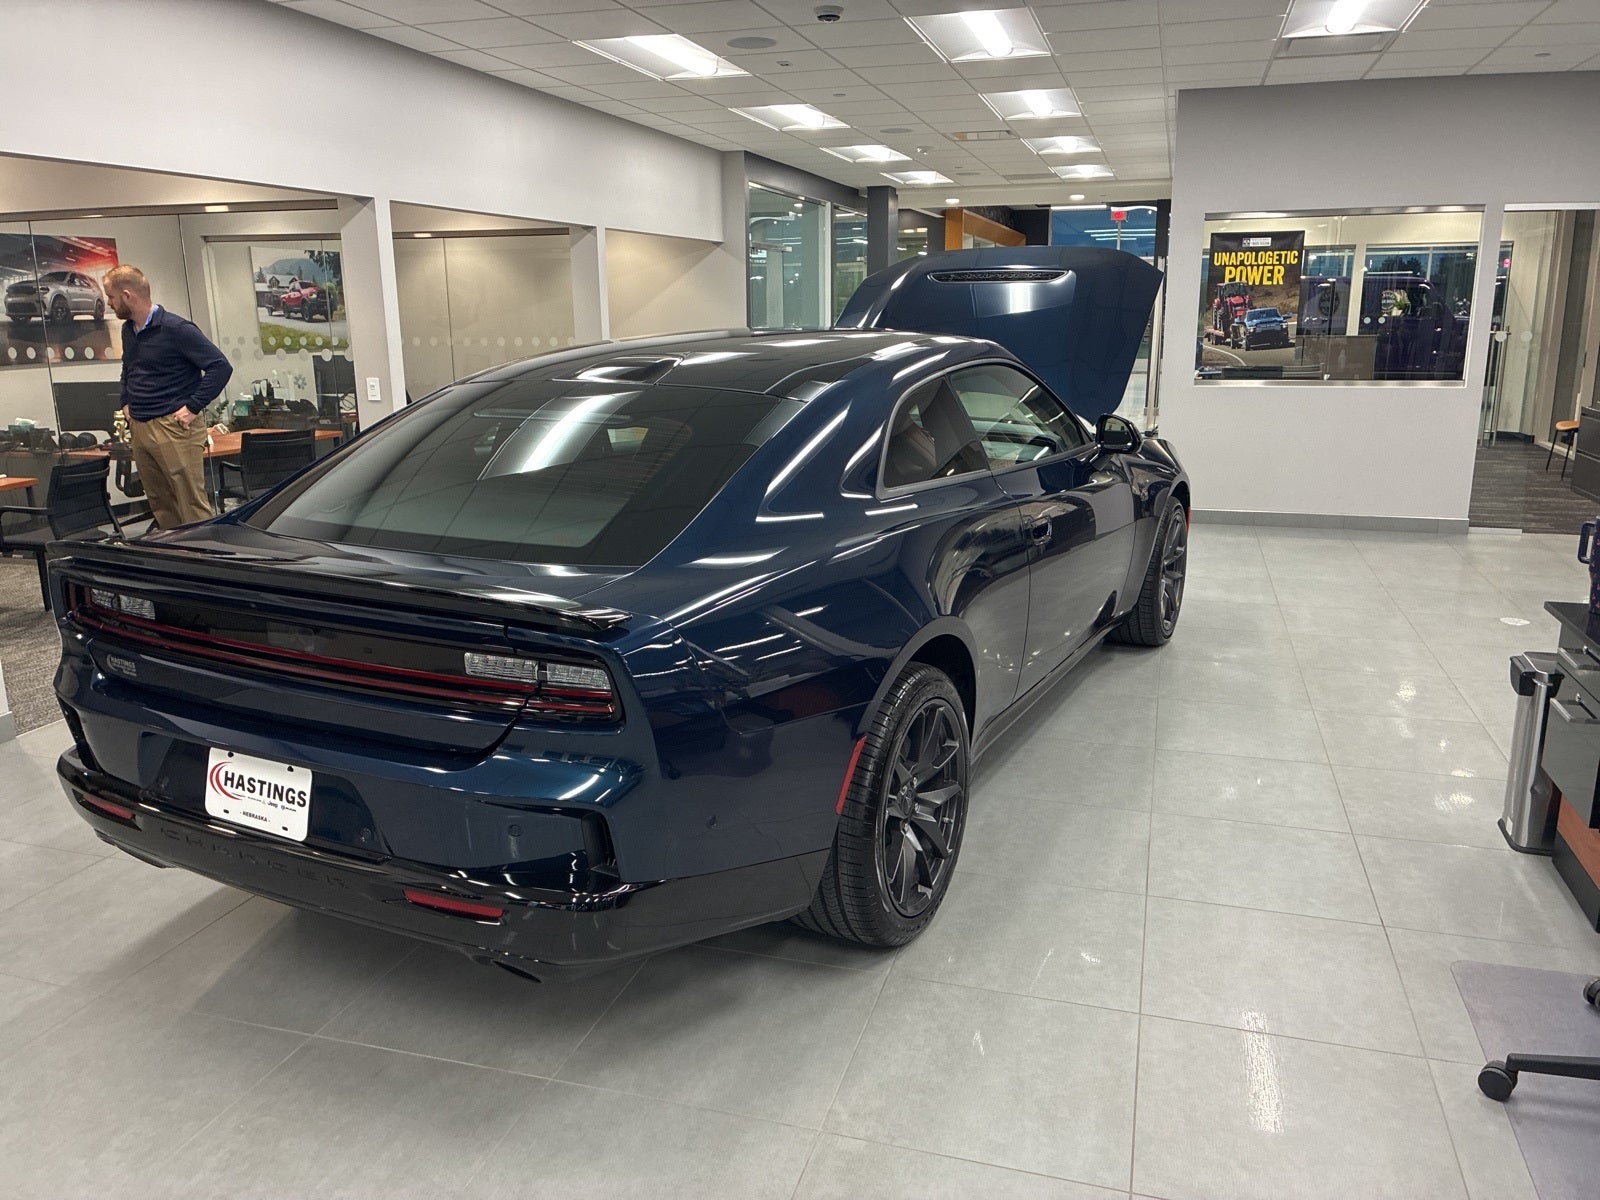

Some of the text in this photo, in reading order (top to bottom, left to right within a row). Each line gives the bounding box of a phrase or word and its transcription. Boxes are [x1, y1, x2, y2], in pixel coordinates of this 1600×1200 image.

[1213, 250, 1299, 266] UNAPOLOGETIC
[1224, 265, 1285, 286] POWER
[223, 770, 307, 808] HASTINGS
[242, 810, 268, 822] NEBRASKA
